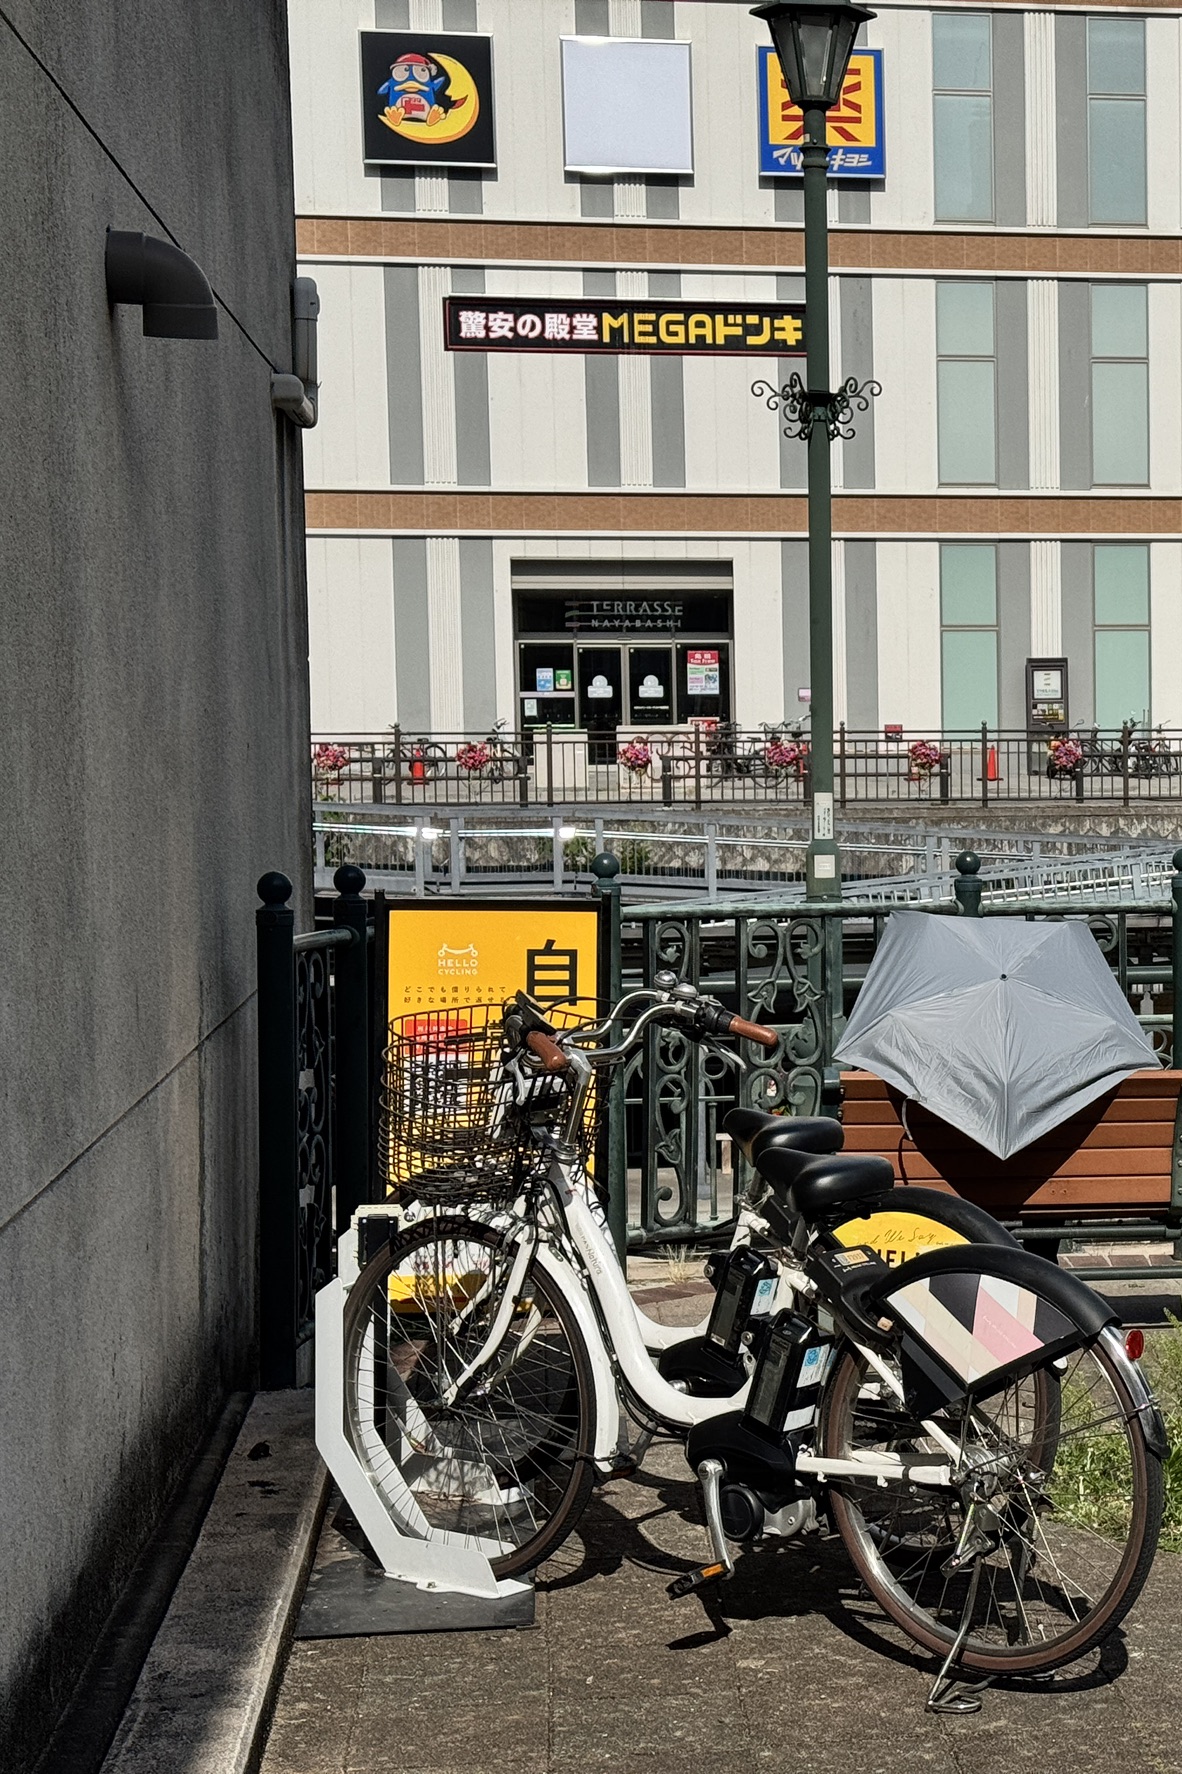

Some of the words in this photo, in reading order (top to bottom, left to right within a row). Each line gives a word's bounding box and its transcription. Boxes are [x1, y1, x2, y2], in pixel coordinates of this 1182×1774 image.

[459, 310, 599, 341] 驚安の殿堂
[601, 312, 803, 346] MEGAドンキ
[591, 619, 682, 628] NAYABASHI
[437, 958, 479, 968] HELLO
[437, 968, 479, 976] CYCLING
[526, 938, 578, 1007] 自
[403, 985, 507, 994] どこでも借りられて
